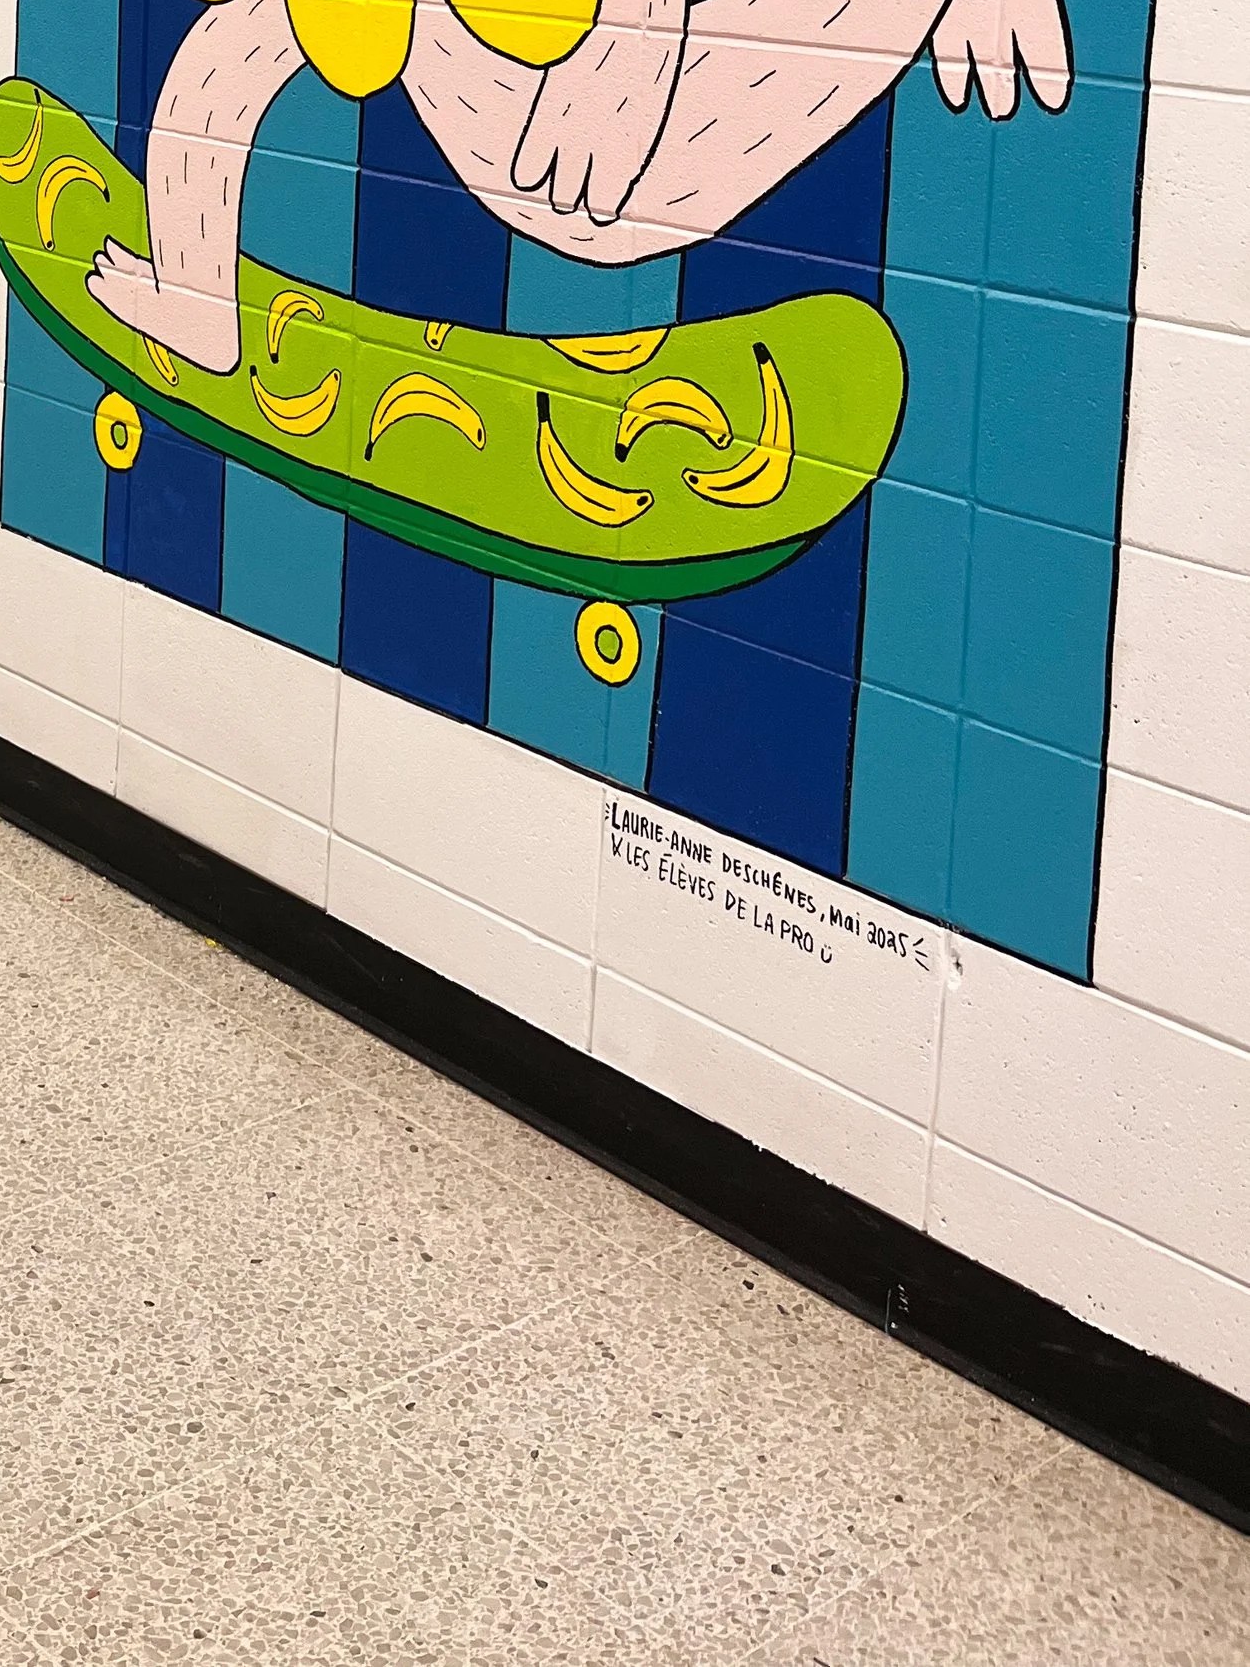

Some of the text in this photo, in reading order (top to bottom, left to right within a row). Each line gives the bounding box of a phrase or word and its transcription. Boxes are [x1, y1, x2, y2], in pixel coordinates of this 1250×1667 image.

[611, 802, 713, 864] LAURIE-ANNE
[867, 921, 909, 958] 2025
[626, 841, 651, 872] LES
[658, 853, 716, 902] ÉLÈVES
[725, 889, 747, 920] DE
[753, 905, 774, 935] LA
[780, 919, 814, 953] PRO
